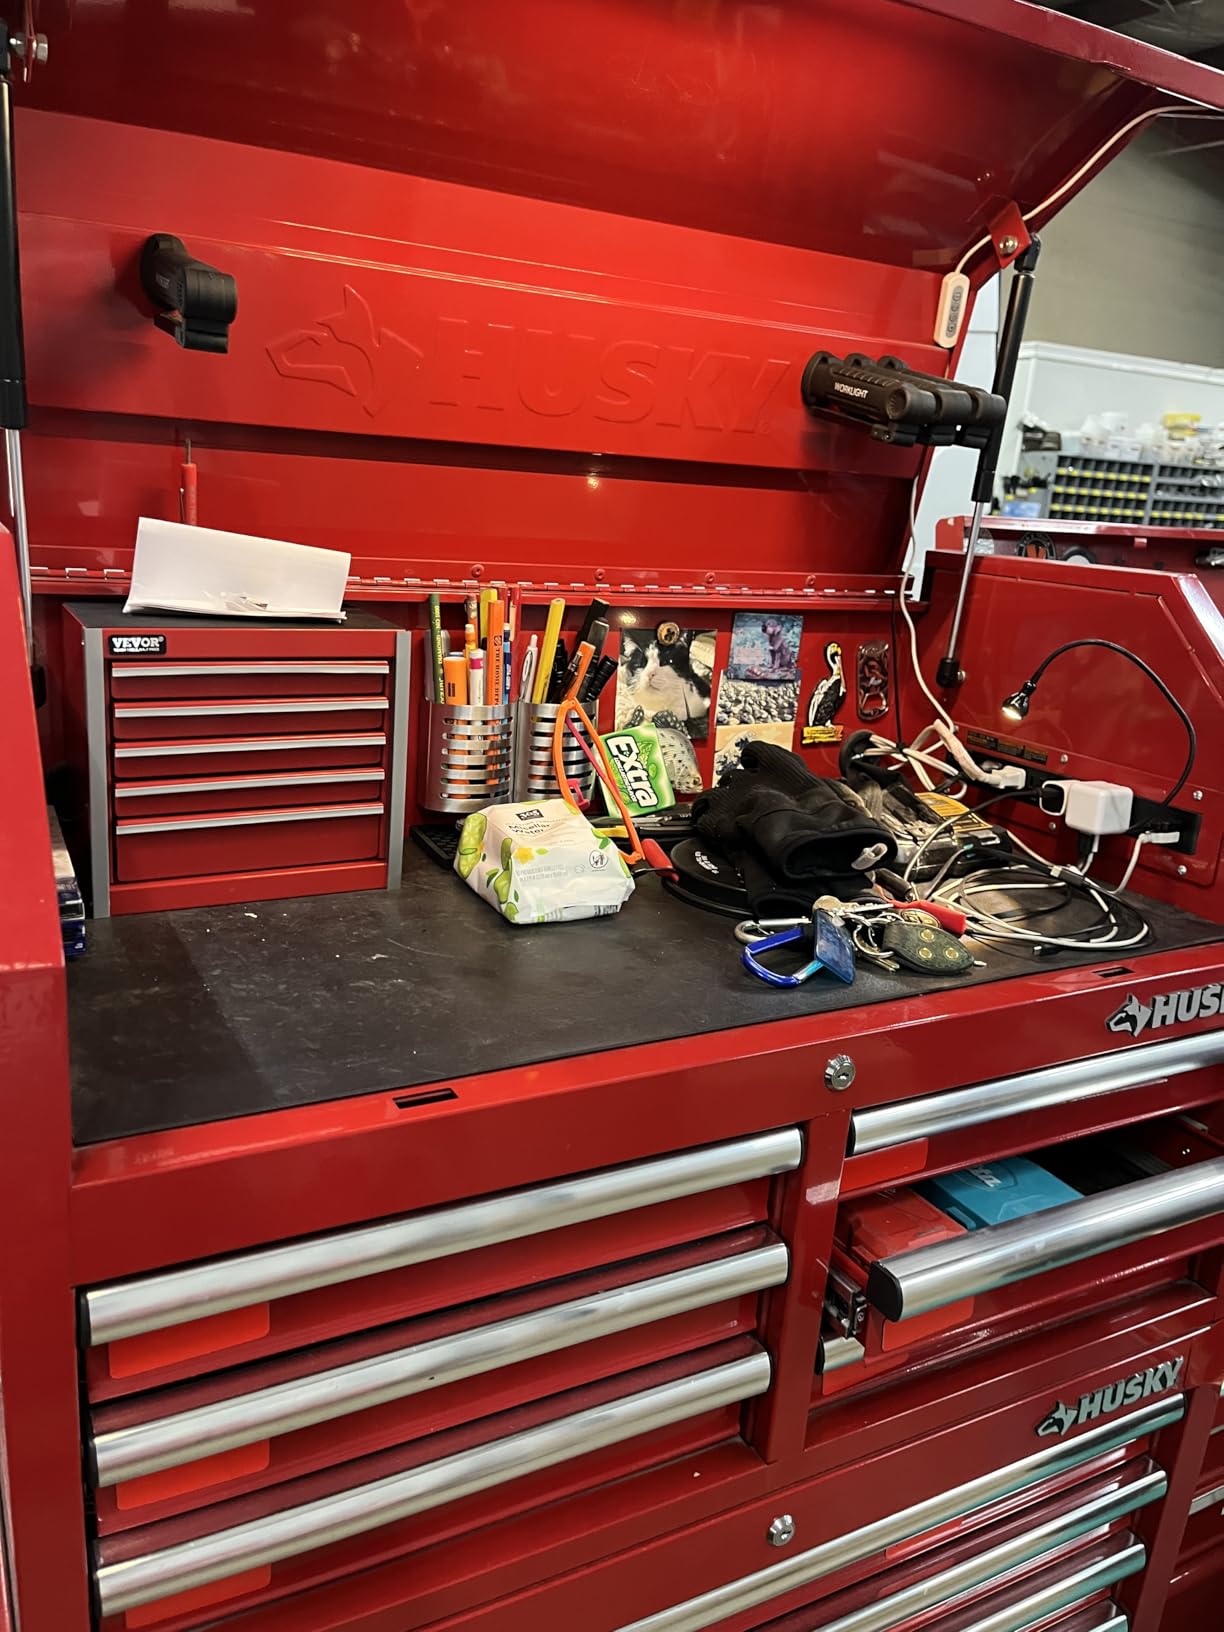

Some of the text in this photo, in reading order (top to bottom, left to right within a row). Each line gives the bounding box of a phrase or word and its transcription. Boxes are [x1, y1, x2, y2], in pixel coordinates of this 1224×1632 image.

[430, 317, 791, 433] HUSKY
[834, 382, 869, 399] WORKLIGHT
[111, 637, 160, 648] VEVOR
[605, 735, 659, 807] Extra
[1149, 981, 1224, 1029] HUS
[1077, 1355, 1184, 1425] HUSKY
